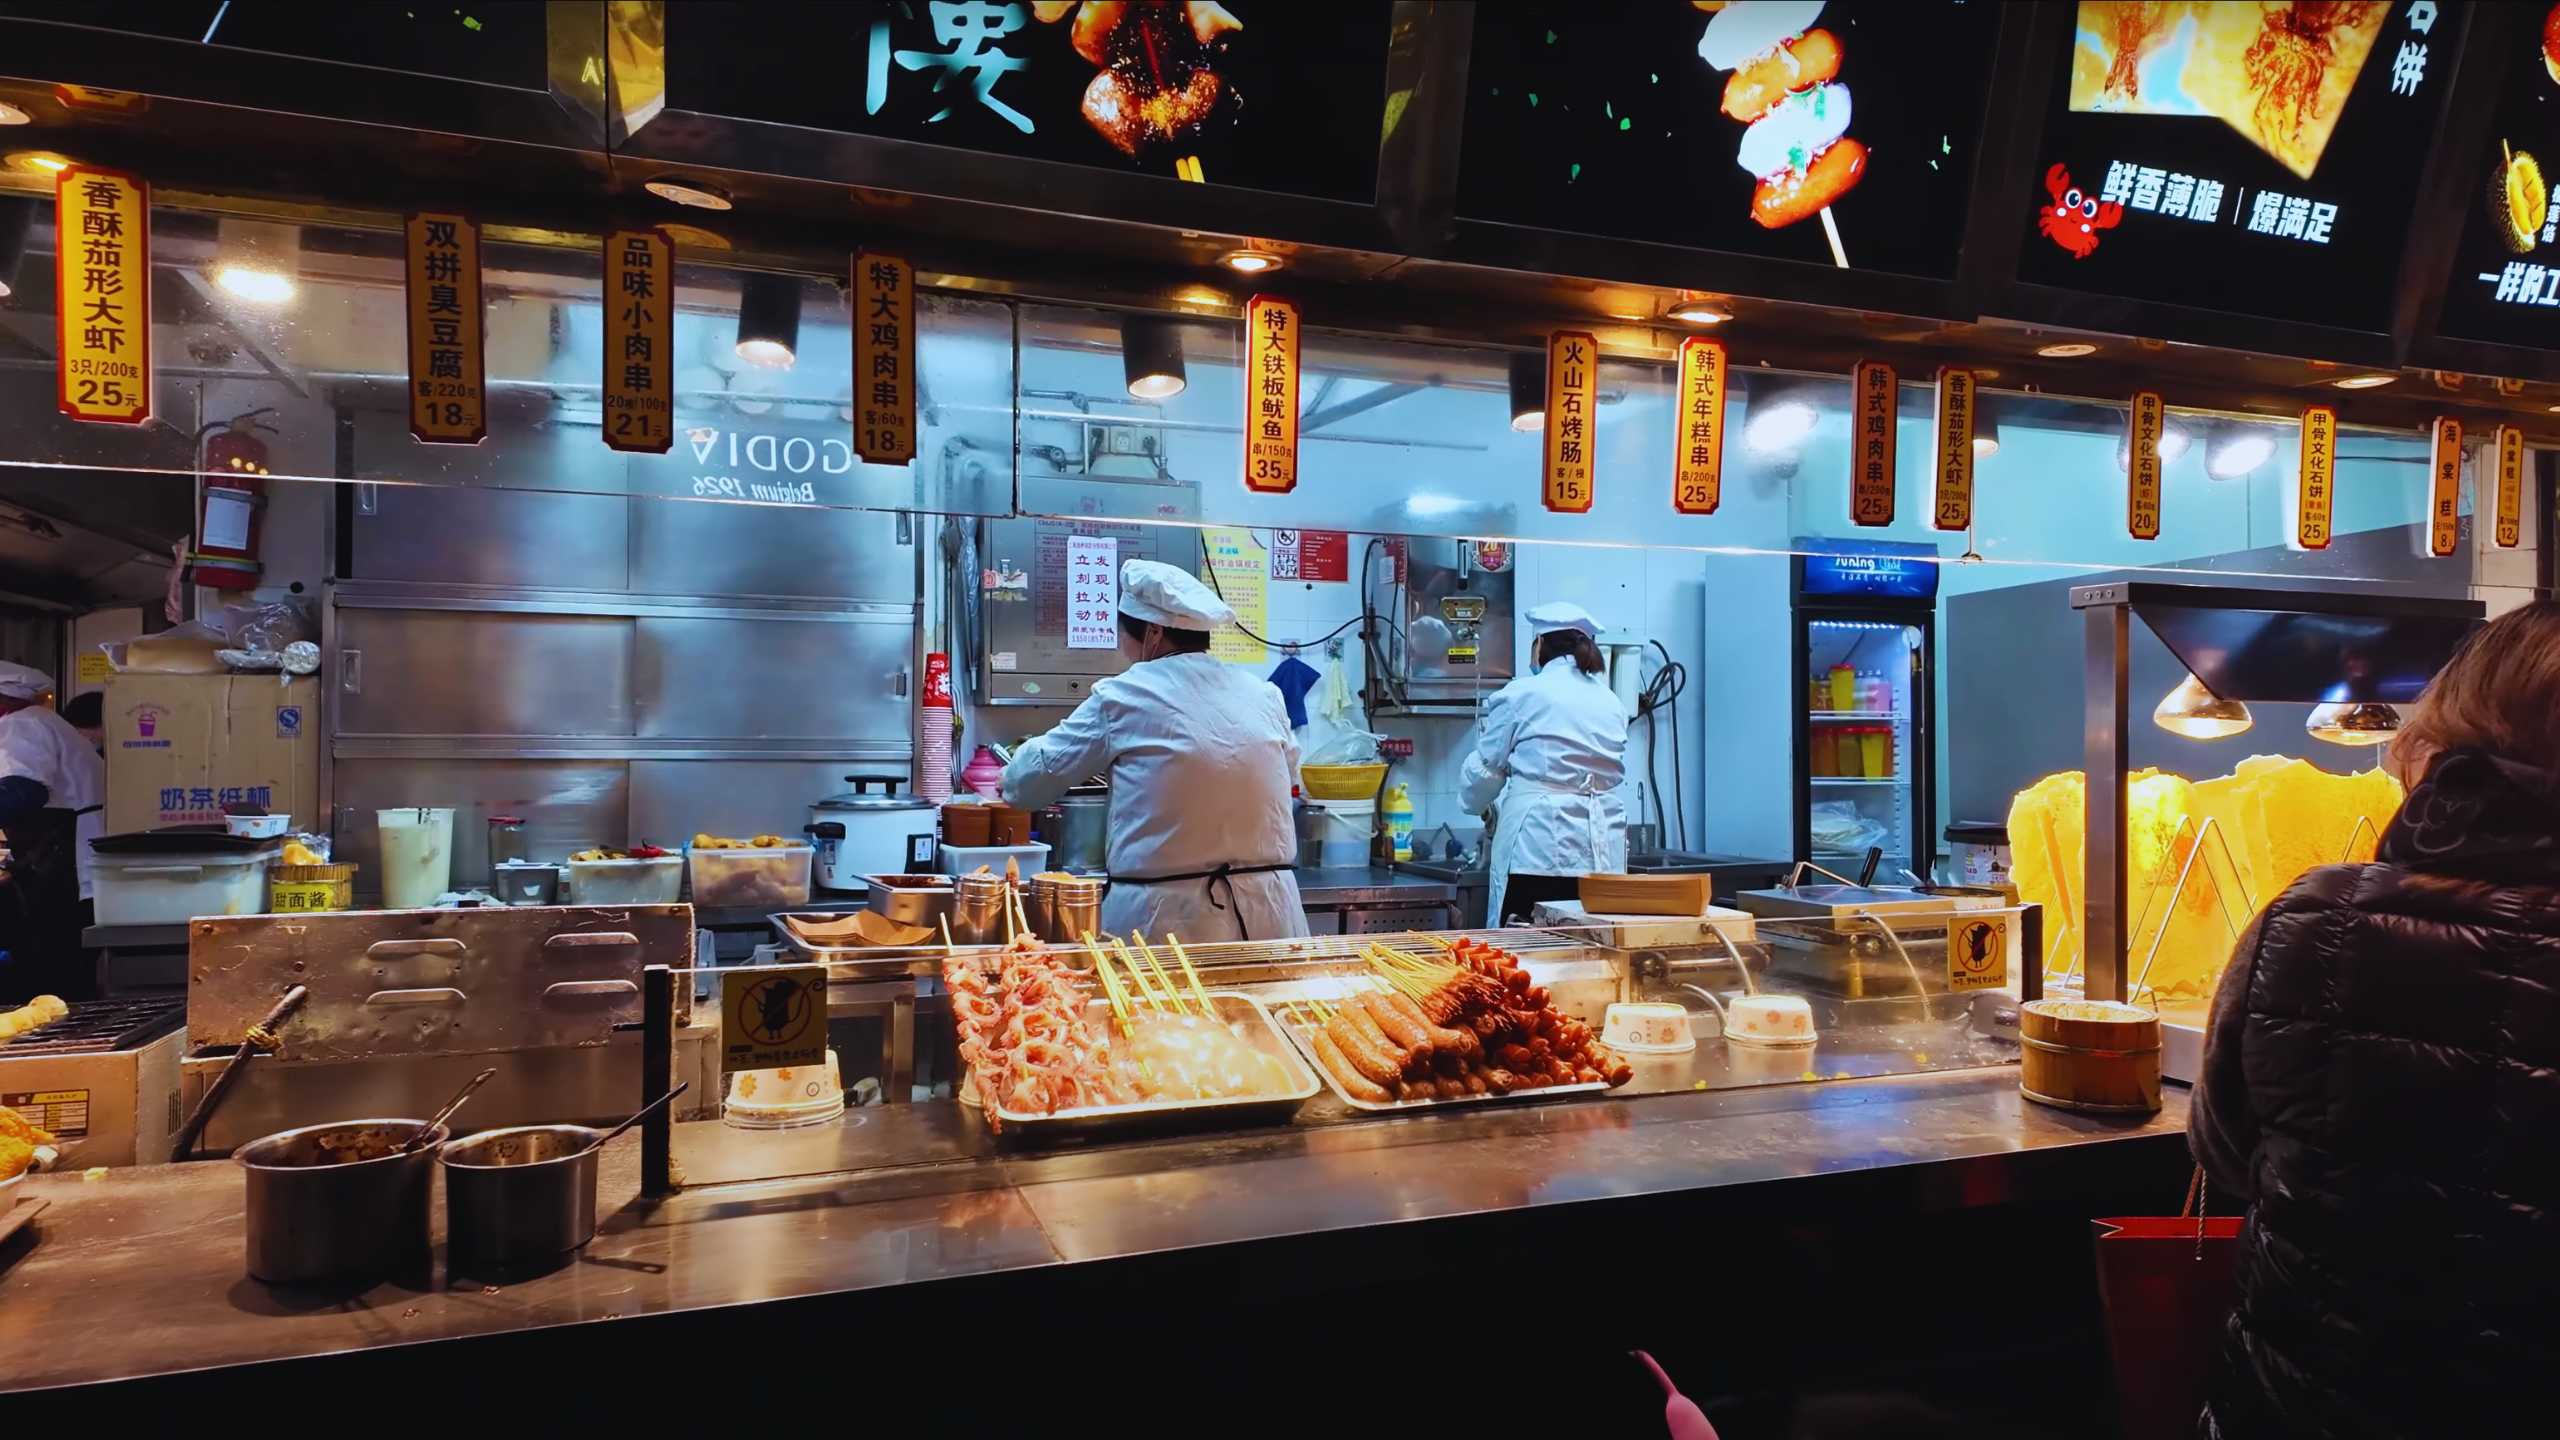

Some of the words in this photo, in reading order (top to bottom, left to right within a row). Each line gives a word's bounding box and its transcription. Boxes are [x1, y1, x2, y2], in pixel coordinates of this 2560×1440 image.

[2100, 160, 2225, 223] 鲜香薄脆
[2248, 190, 2338, 244] 爆满足
[82, 176, 125, 353] 香酥茄形大虾
[424, 220, 463, 379] 双拼臭豆腐
[622, 238, 654, 392] 品味小肉串
[71, 359, 139, 378] 3只/200克
[869, 262, 899, 408] 特大鸡肉串
[1262, 309, 1288, 440] 特大铁板鱿鱼
[78, 379, 138, 407] 25元
[425, 402, 477, 426] 18元
[1560, 342, 1584, 464] 火山石烤肠
[1691, 349, 1715, 467] 韩式年糕串
[1867, 368, 1887, 483] 韩式鸡肉串
[1946, 375, 1966, 486] 香酥茄形大虾
[2138, 396, 2156, 486] 甲骨文化石饼
[1256, 459, 1291, 480] 35元
[2309, 413, 2326, 498] 甲骨文化石饼
[275, 891, 328, 909] 甜面酱
